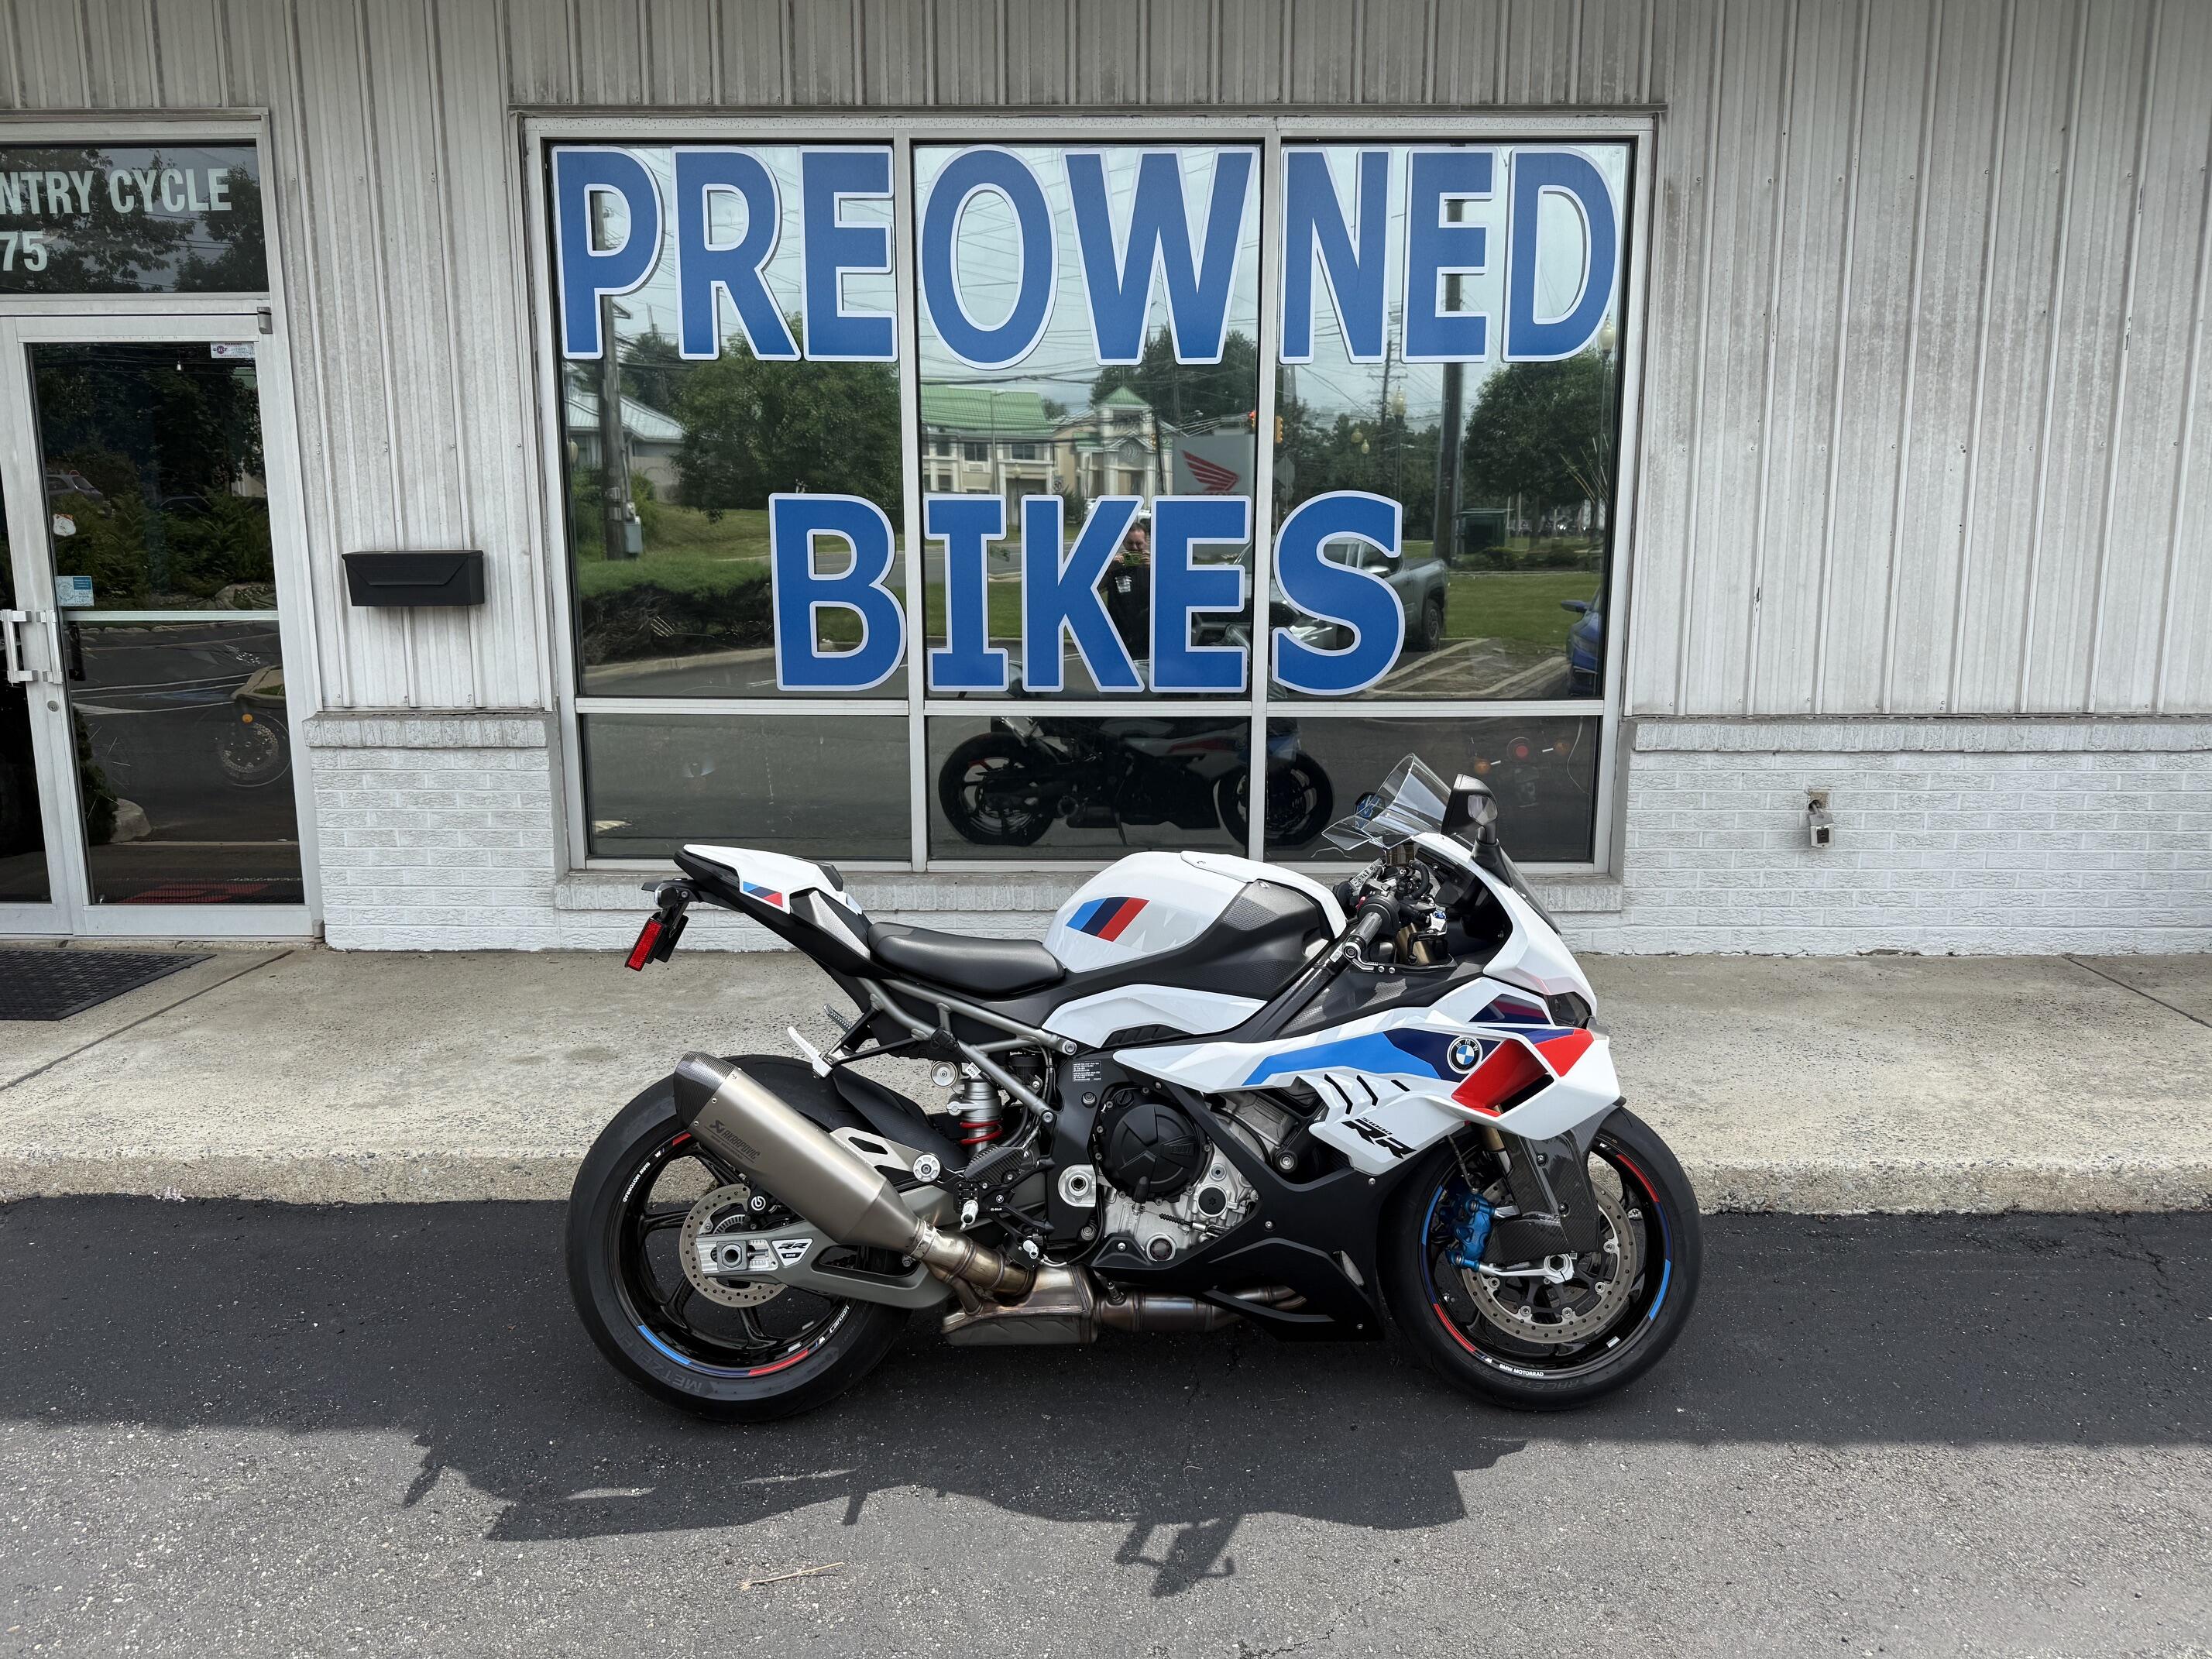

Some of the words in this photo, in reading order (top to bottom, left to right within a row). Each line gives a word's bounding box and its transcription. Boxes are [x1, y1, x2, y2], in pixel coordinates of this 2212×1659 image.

[0, 170, 94, 215] NTRY
[110, 168, 232, 213] CYCLE
[0, 231, 48, 272] 75
[551, 144, 1621, 370] PREOWNED
[768, 489, 1406, 696] BIKES
[1341, 1118, 1417, 1159] RR
[623, 1173, 641, 1202] MOTORRAD
[639, 1162, 651, 1175] BMW
[1499, 1363, 1513, 1372] BMW
[1513, 1368, 1544, 1377] MOTORRAD
